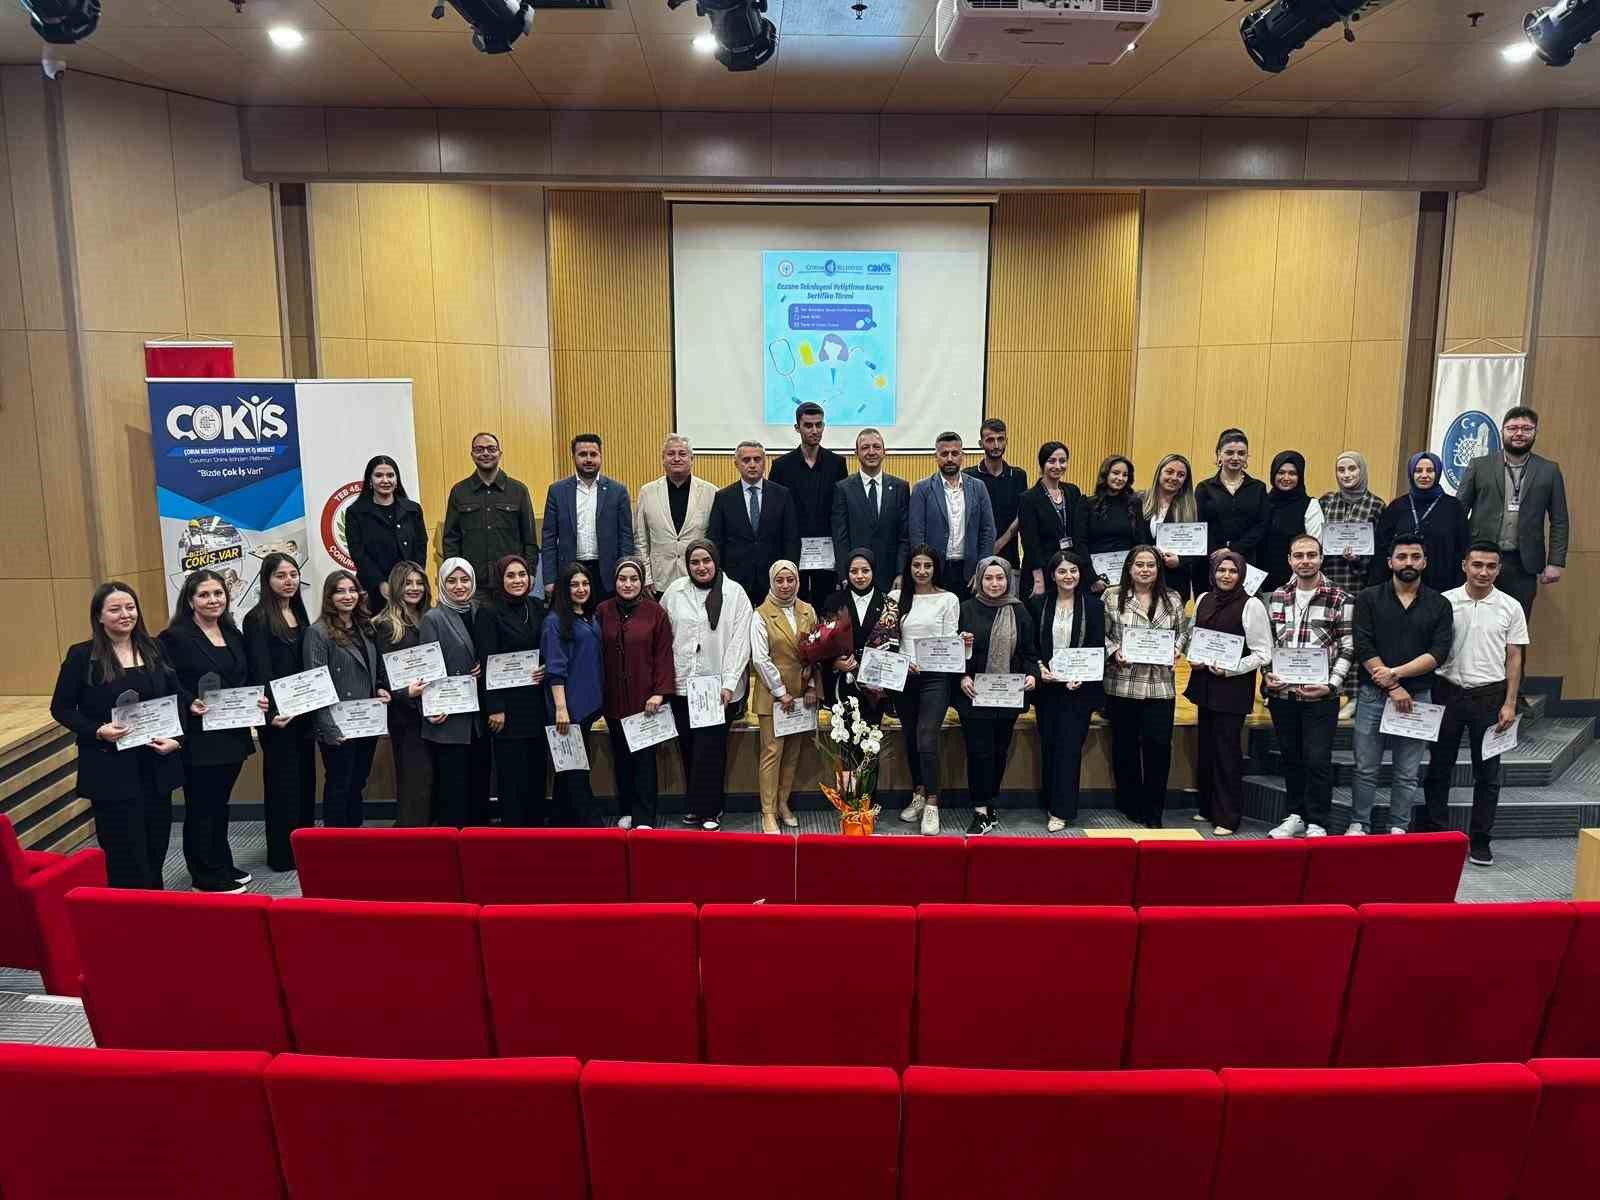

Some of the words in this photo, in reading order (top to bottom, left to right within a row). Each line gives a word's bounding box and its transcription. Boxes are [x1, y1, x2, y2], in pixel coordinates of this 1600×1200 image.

[222, 467, 238, 477] Çok
[334, 488, 349, 502] TEB
[218, 547, 239, 561] VAR
